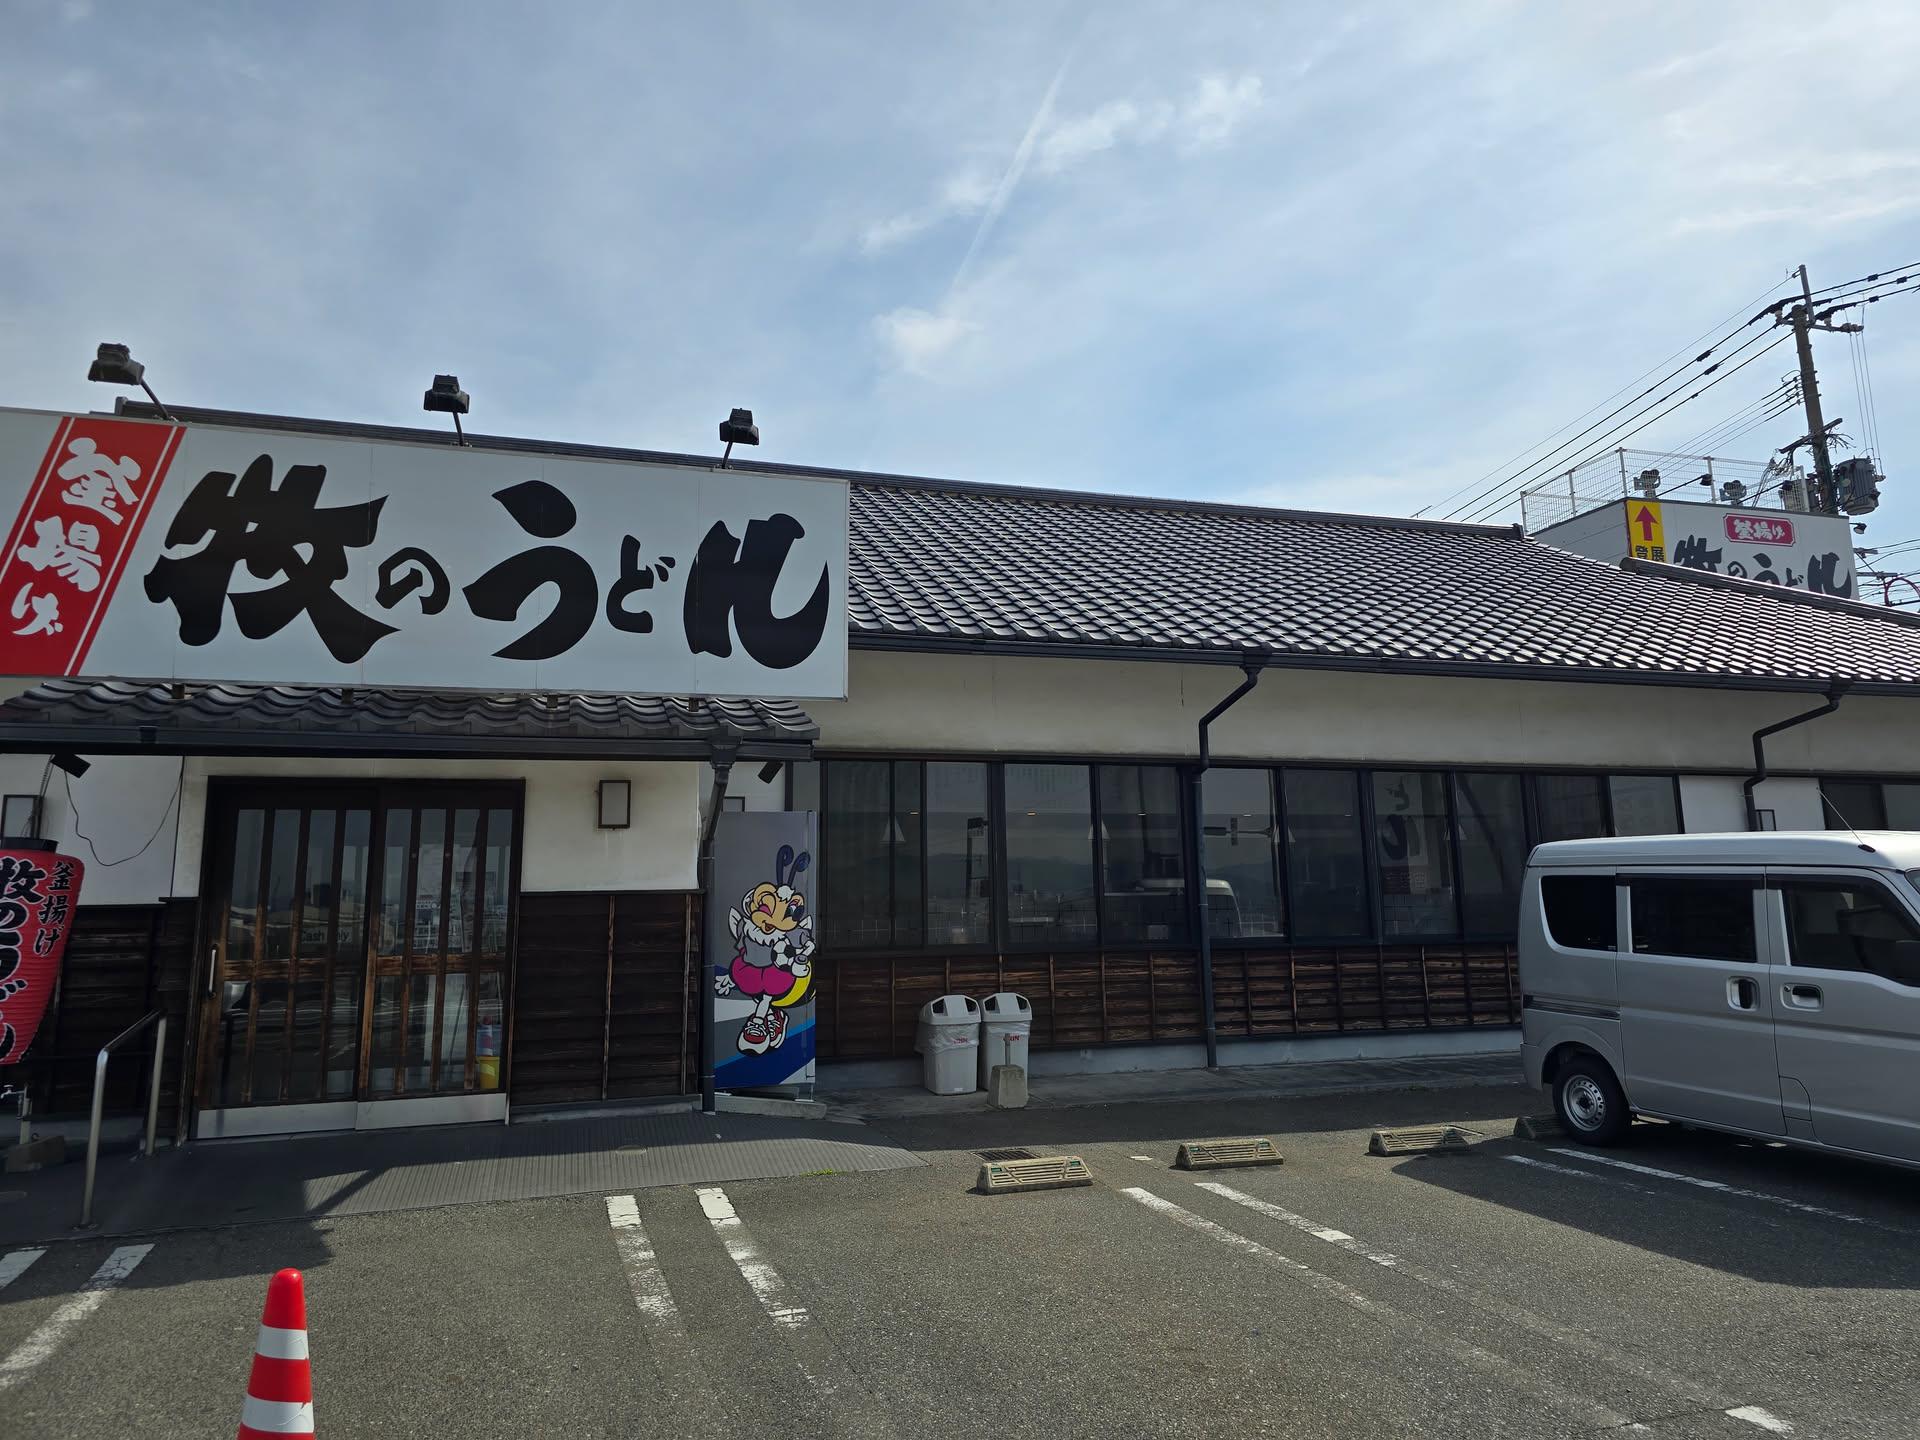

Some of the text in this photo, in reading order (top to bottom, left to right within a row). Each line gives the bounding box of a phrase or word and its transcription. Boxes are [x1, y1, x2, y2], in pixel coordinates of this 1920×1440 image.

[143, 454, 829, 669] 牧のうどん
[1733, 519, 1785, 540] 釜揚げ
[34, 861, 75, 957] 釜揚げ
